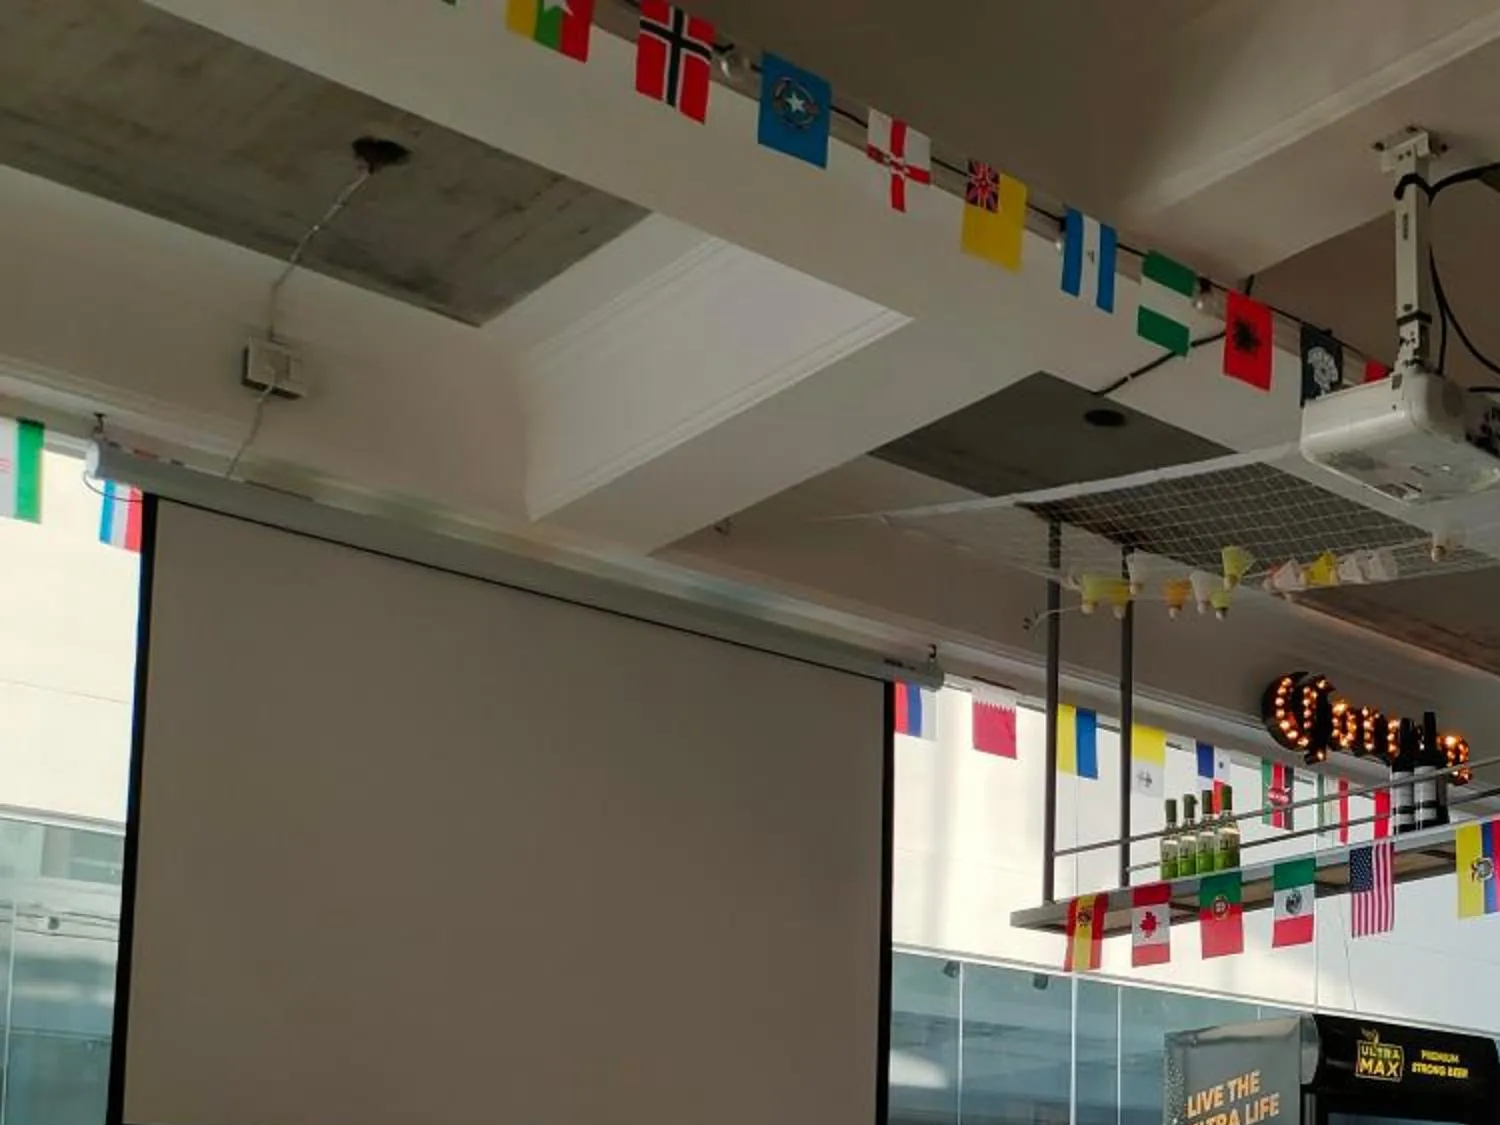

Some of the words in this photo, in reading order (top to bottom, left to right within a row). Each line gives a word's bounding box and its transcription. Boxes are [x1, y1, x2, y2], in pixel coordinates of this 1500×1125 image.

[1360, 1045, 1401, 1061] ULTRA
[1359, 1057, 1400, 1078] MAX
[1186, 1083, 1225, 1120] LIVE
[1226, 1069, 1262, 1102] THE
[1245, 1091, 1281, 1125] LIFE
